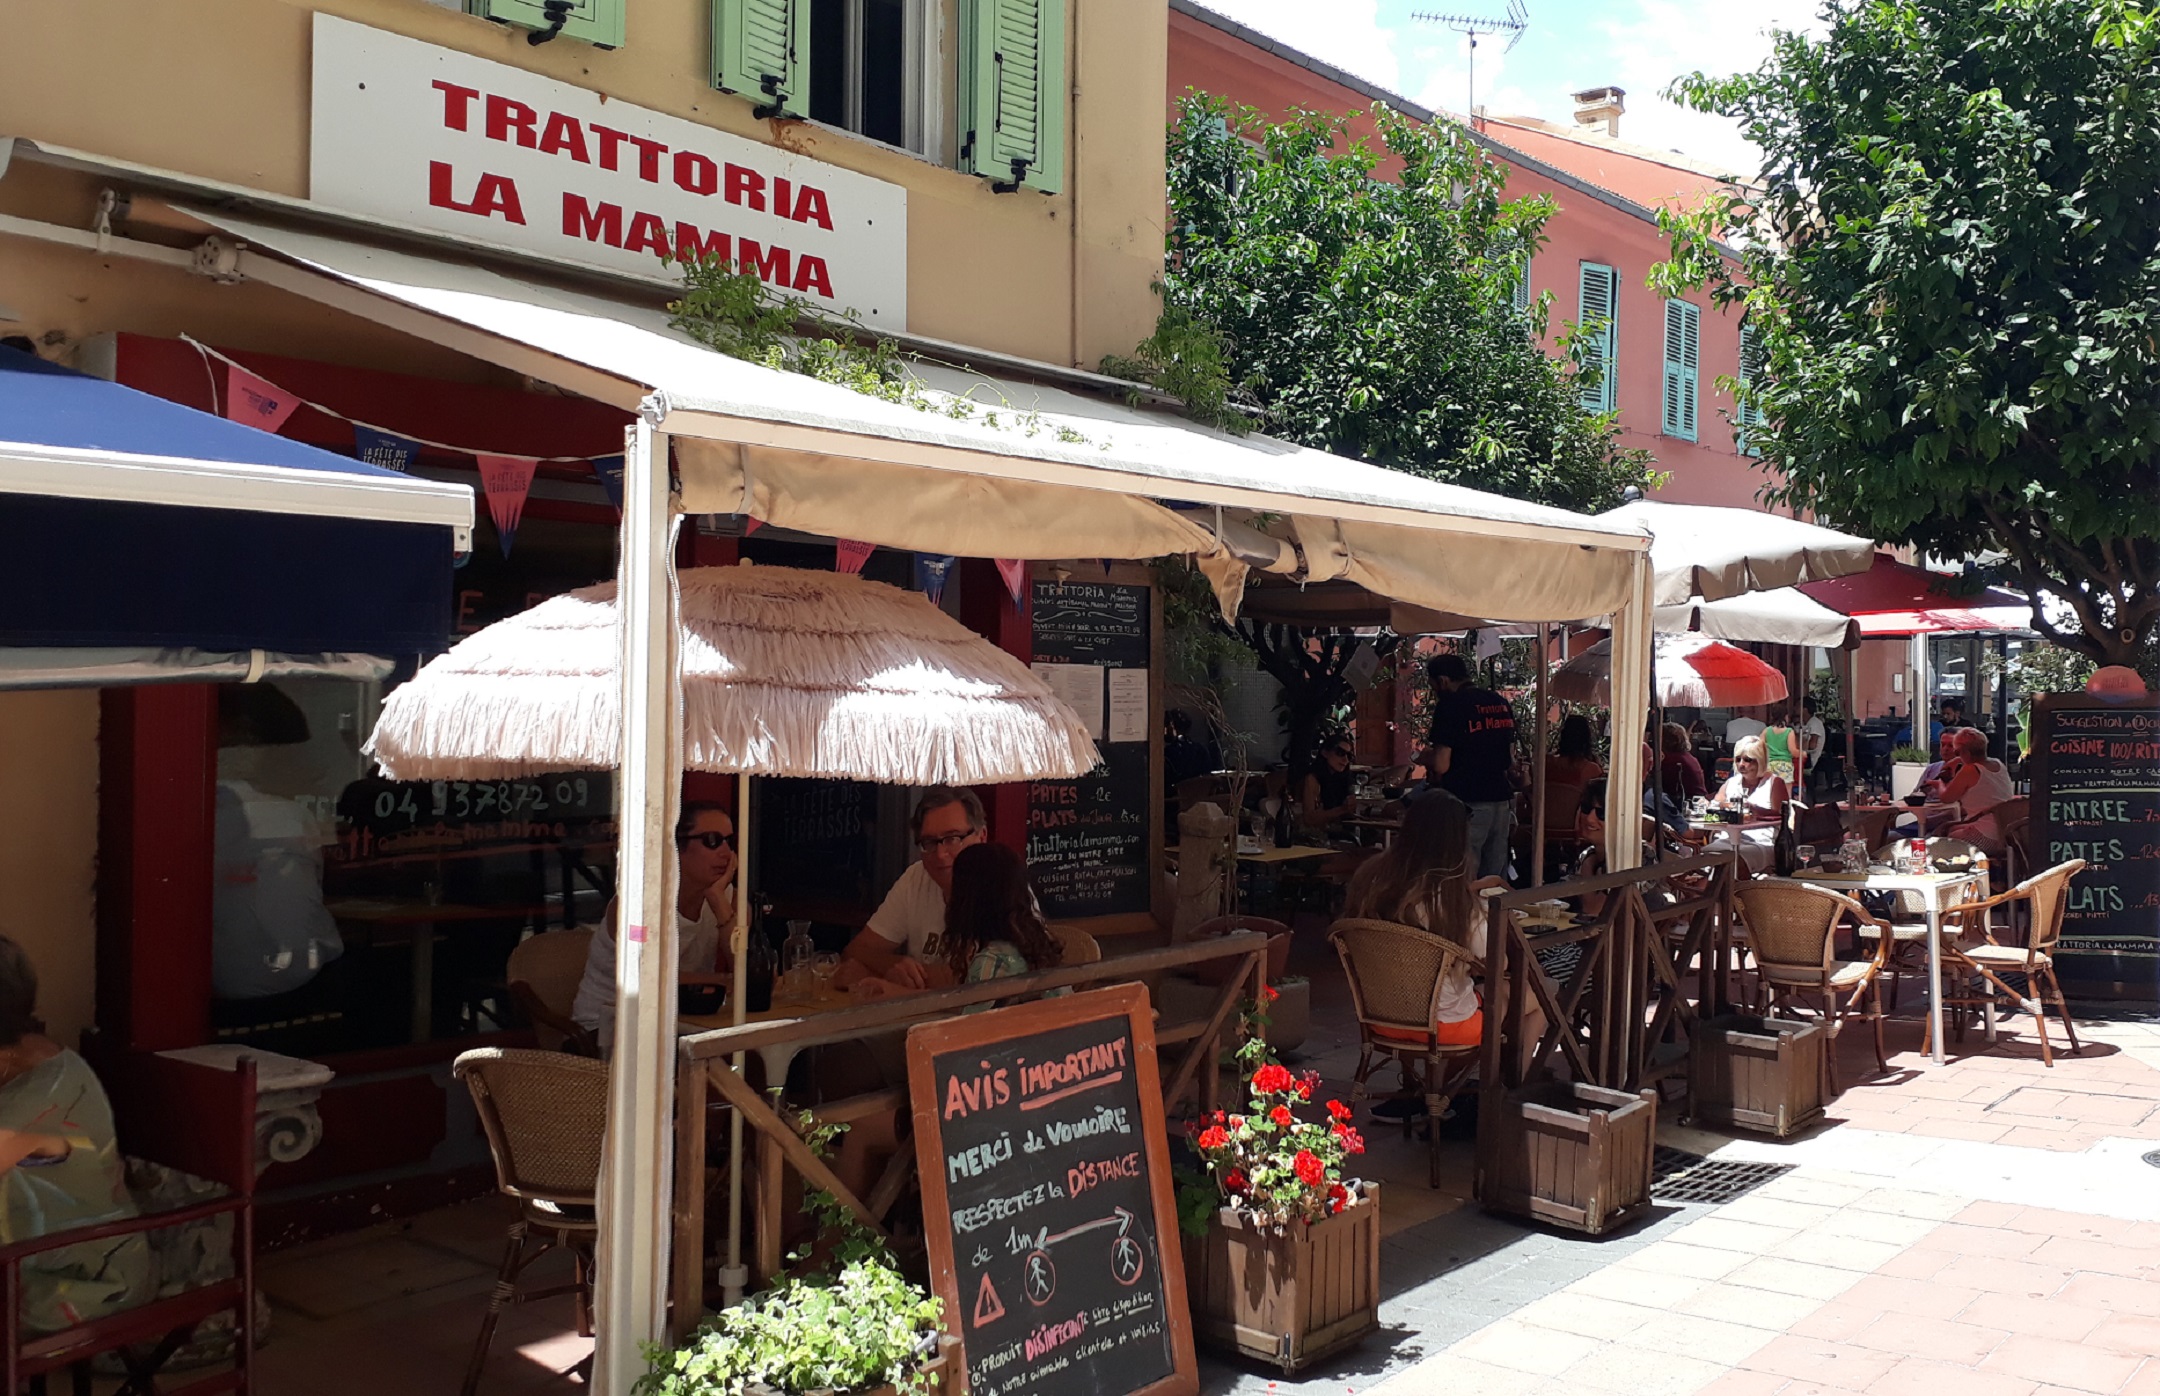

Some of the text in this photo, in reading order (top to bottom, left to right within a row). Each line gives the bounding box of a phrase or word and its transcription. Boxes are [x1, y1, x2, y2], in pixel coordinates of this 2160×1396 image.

[432, 79, 833, 231] TRATTORIA
[429, 160, 834, 299] LA MAMMA
[1034, 583, 1106, 599] TRTTORIA
[1468, 719, 1483, 734] La
[2050, 736, 2106, 758] CUISINE
[374, 787, 418, 823] 04
[1031, 783, 1078, 804] PATES
[783, 804, 862, 846] TERRASSES
[1031, 809, 1078, 828] PLATS
[2050, 838, 2124, 862] PATES
[2067, 886, 2125, 911] LATS
[945, 1037, 1127, 1120] AVIS IMPORTANT
[947, 1131, 1013, 1184] MERCI
[1022, 1129, 1046, 1154] de
[951, 1151, 1140, 1235] RESPECTEZ la DISTANCE
[971, 1225, 1034, 1268] de 1m
[982, 1341, 1023, 1374] PRODUIT
